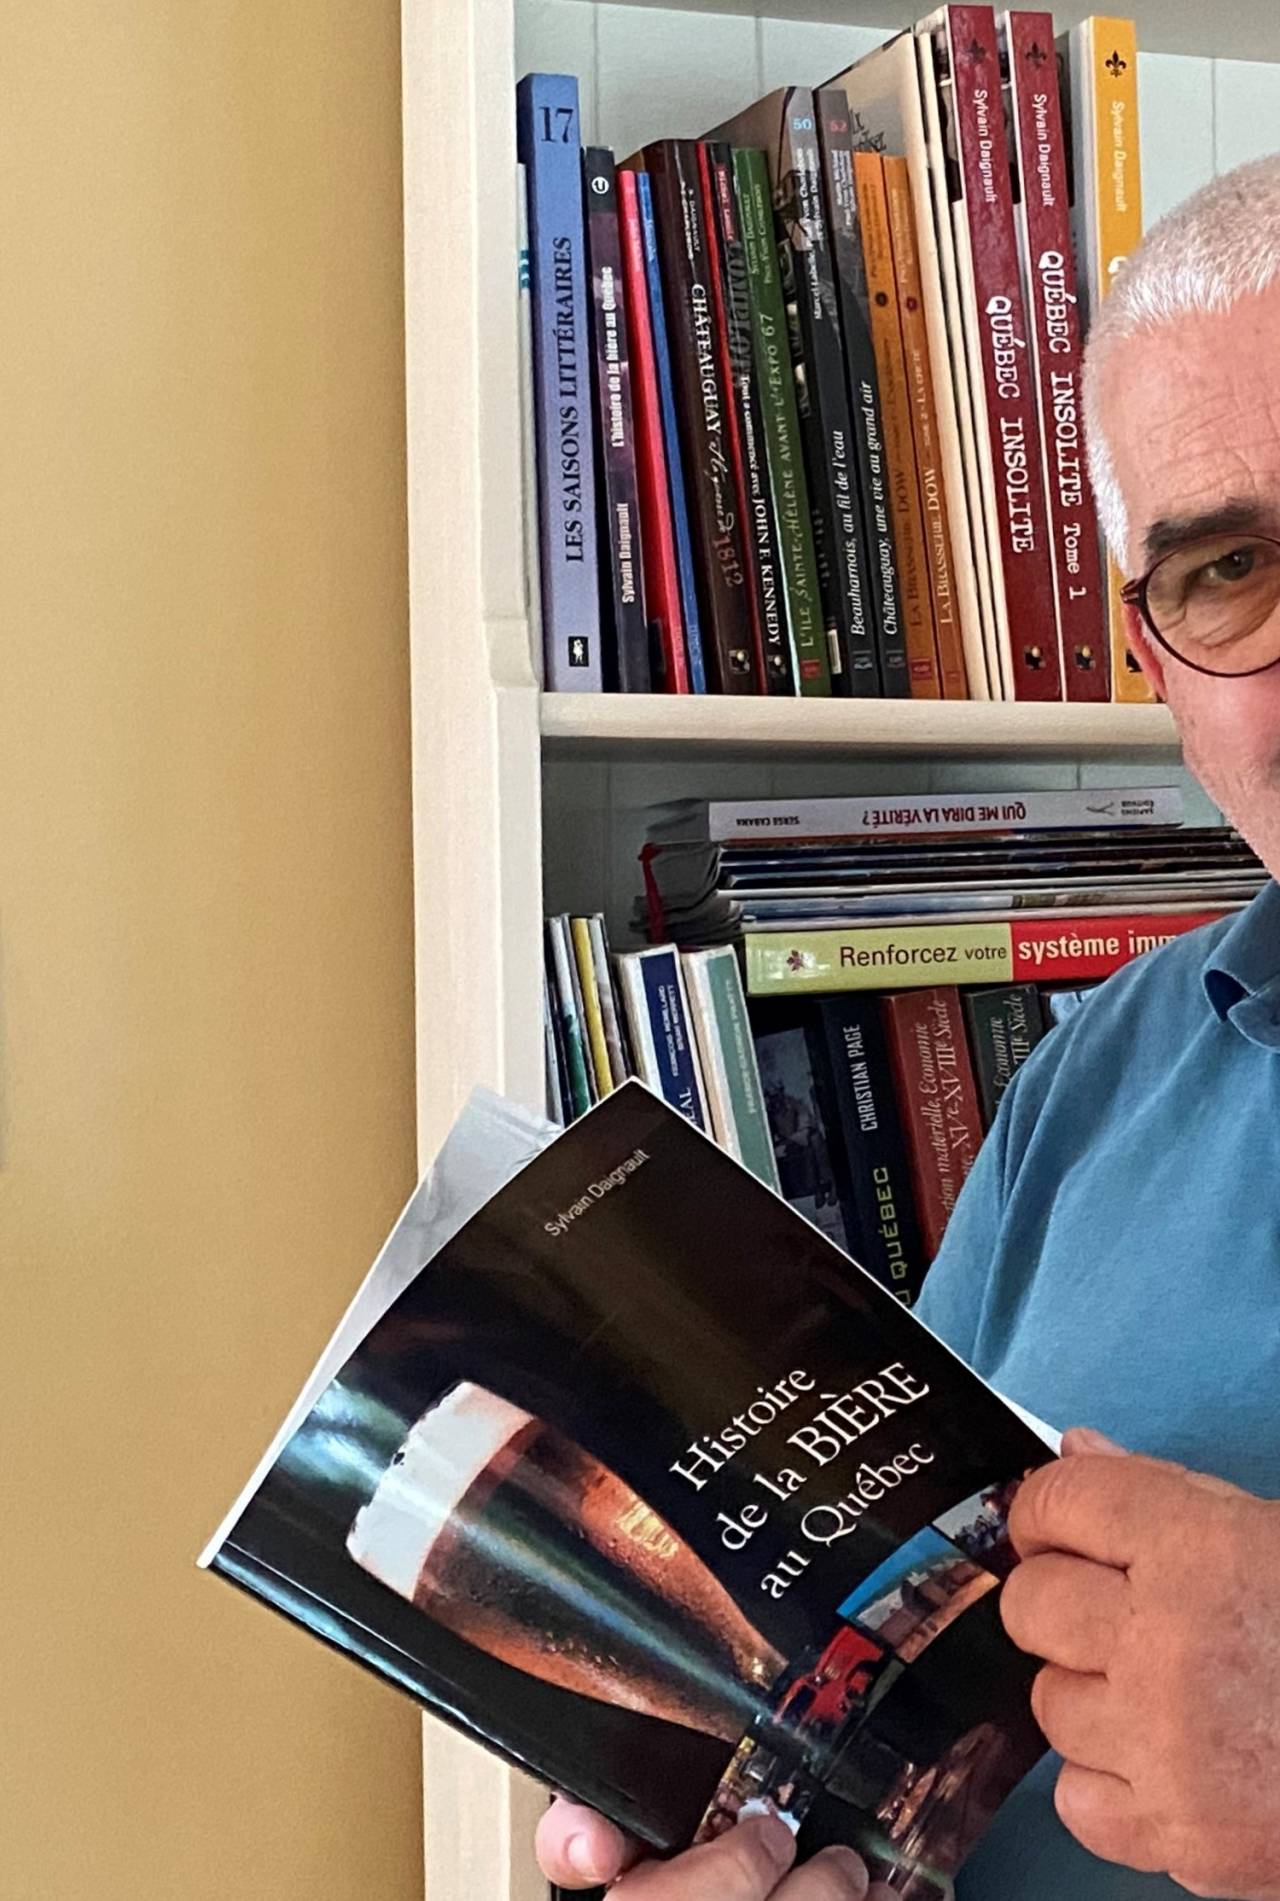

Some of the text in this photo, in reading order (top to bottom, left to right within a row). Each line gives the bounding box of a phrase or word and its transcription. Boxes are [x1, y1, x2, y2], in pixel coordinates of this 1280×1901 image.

[539, 106, 574, 142] 17
[793, 117, 812, 131] 50
[1111, 100, 1129, 212] Sylvain Daignault
[604, 313, 616, 327] au
[759, 312, 776, 337] 67
[972, 90, 1034, 553] Sylvain Daignault QUÉBEC INSOLITE
[1032, 94, 1087, 600] Sylvain Daignault QUÉBEC INSOLITE Tome 1
[606, 363, 619, 374] la
[607, 377, 620, 391] de
[740, 375, 753, 401] Tout
[553, 237, 584, 562] LES SAISONS LITTÉRAIRES
[691, 283, 743, 588] CHÂTEAUGUAY 1812
[744, 411, 761, 470] commencé
[776, 414, 792, 462] AVANT
[859, 381, 899, 636] Châteauguay, une vie au grand air
[894, 469, 909, 512] DOW
[924, 465, 940, 511] DOW
[752, 497, 770, 544] JOHN
[830, 430, 866, 636] Beauharnois, au fil de l'eau
[616, 503, 635, 603] Sylvain Daignault
[757, 548, 770, 560] F.
[760, 564, 781, 646] KENNEDY
[736, 815, 801, 827] SERGE CABANA
[862, 801, 1027, 826] QUI ME DIRA LA VÉRITÉ ?
[840, 929, 1120, 968] Renforcez votre système
[842, 1024, 879, 1131] CHRISTIAN PAGE
[544, 1148, 651, 1237] Sylvain Daignault
[873, 1167, 908, 1280] QUÉBEC
[668, 1369, 816, 1491] Histoire
[716, 1362, 931, 1550] de la BIÈRE
[760, 1443, 936, 1599] au Québec
